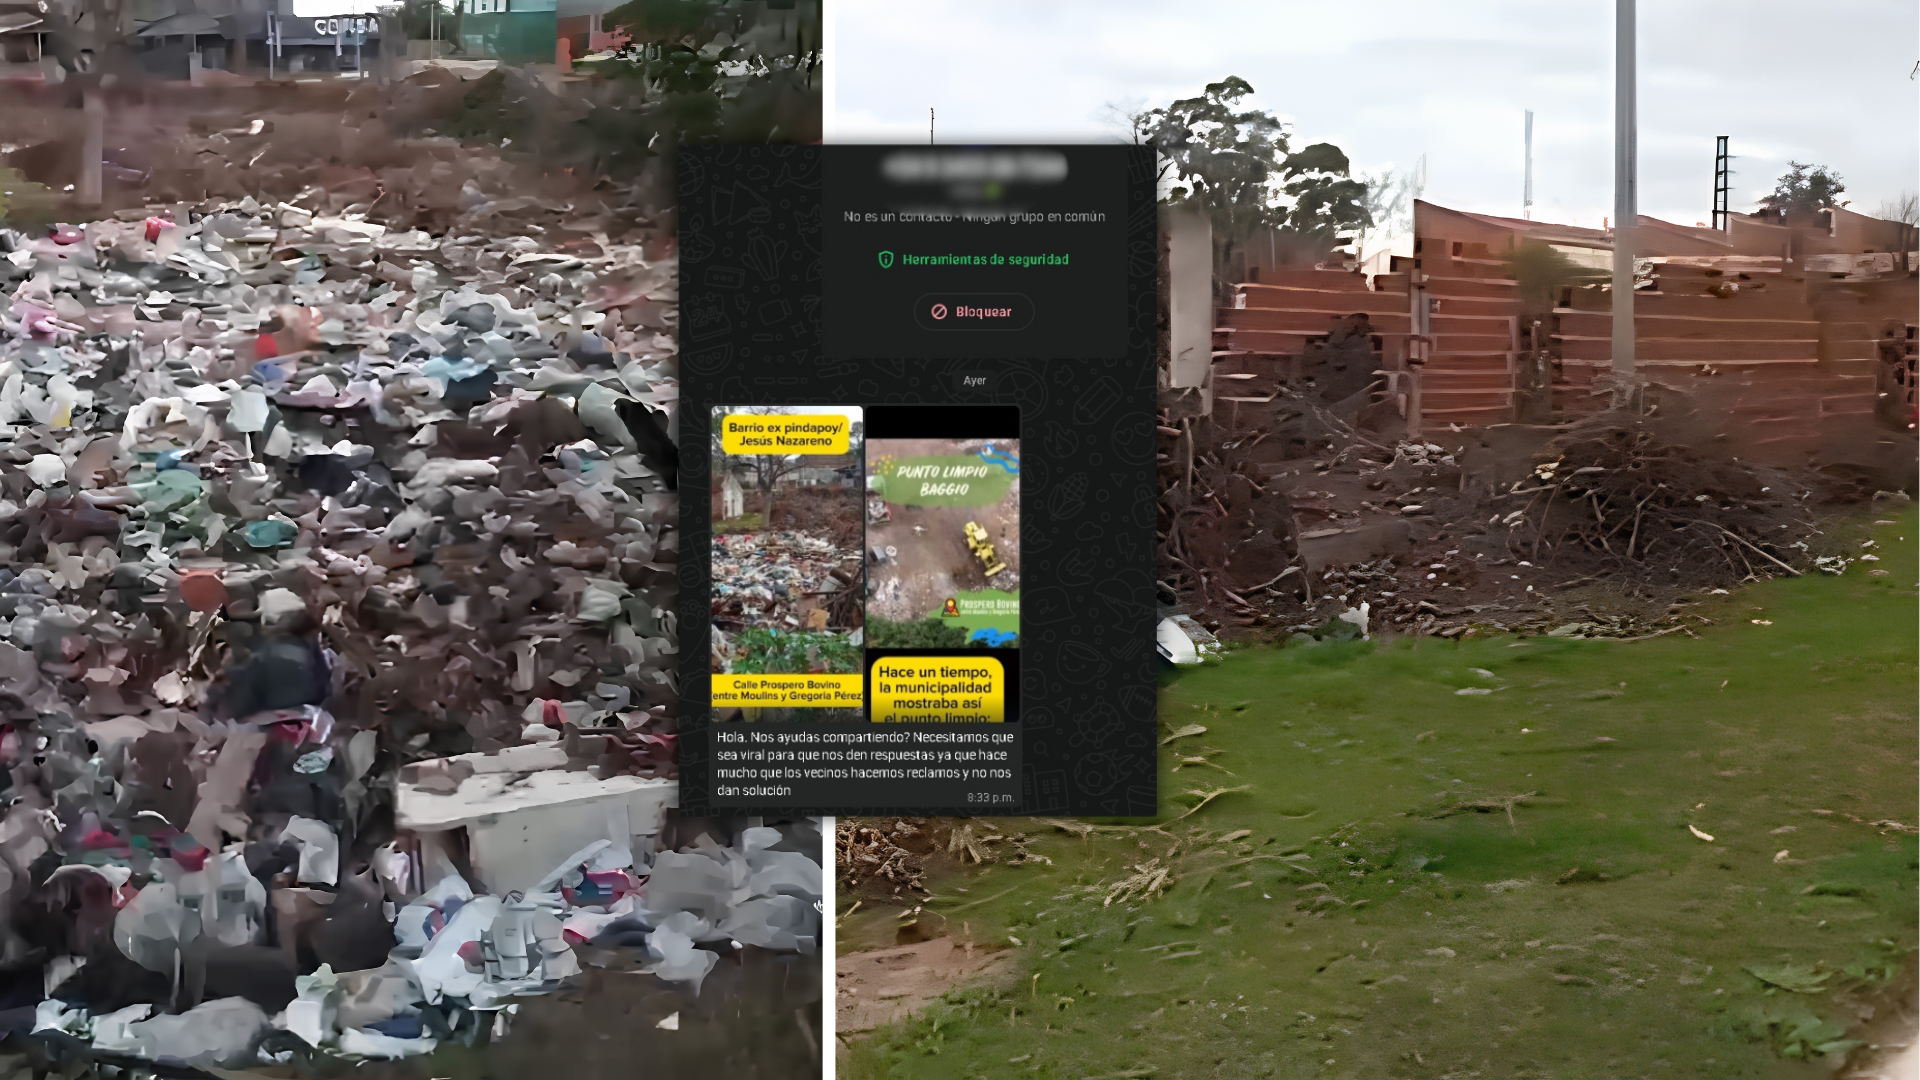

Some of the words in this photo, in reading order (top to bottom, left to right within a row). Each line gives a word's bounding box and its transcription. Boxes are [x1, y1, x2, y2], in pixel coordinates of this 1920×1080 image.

[844, 211, 861, 222] No
[864, 213, 878, 222] es
[881, 212, 896, 222] un
[1009, 212, 1044, 225] grupo
[1047, 213, 1062, 222] en
[1064, 210, 1106, 222] común
[902, 253, 988, 265] Herramientas
[989, 253, 1005, 265] de
[1008, 253, 1069, 268] seguridad
[956, 305, 1012, 320] Bloquear
[963, 375, 987, 388] Ayer
[728, 422, 765, 433] Barrio
[767, 425, 781, 433] ex
[784, 422, 843, 435] pindapoy/
[739, 435, 773, 446] Jesús
[776, 435, 833, 446] Nazareno
[896, 465, 941, 479] PUNTO
[942, 465, 988, 479] LIMPIO
[920, 482, 970, 497] BAGGIO
[878, 665, 915, 678] Hace
[918, 668, 937, 678] un
[940, 666, 992, 680] tiempo,
[733, 680, 758, 690] Calle
[760, 680, 805, 691] Prospero
[806, 680, 841, 690] Bovino
[879, 681, 891, 694] la
[895, 681, 992, 696] municipalidad
[712, 691, 738, 700] entre
[740, 691, 779, 701] Moulins
[780, 694, 787, 702] y
[789, 691, 832, 702] Gregoria
[893, 697, 959, 709] mostraba
[962, 697, 983, 709] así
[883, 713, 897, 723] el
[900, 713, 942, 723] punto
[717, 730, 748, 743] Hola.
[750, 731, 775, 743] Nos
[777, 730, 821, 746] ayudas
[822, 730, 911, 746] compartiendo?
[913, 730, 990, 743] Necesitamos
[991, 733, 1014, 746] que
[717, 750, 738, 761] sea
[739, 748, 765, 761] viral
[767, 751, 795, 764] para
[797, 751, 820, 764] que
[821, 751, 844, 761] nos
[845, 748, 868, 761] den
[870, 750, 936, 764] respuestas
[937, 751, 952, 764] ya
[954, 751, 977, 764] que
[978, 748, 1008, 761] hace
[717, 766, 758, 779] mucho
[760, 768, 783, 781] que
[784, 766, 802, 779] los
[803, 766, 849, 779] vecinos
[850, 766, 905, 779] hacemos
[906, 766, 961, 779] reclamos
[962, 768, 970, 781] y
[972, 768, 987, 779] no
[989, 768, 1012, 779] nos
[717, 784, 740, 796] dan
[742, 784, 791, 796] solución
[967, 792, 990, 803] 8:33
[992, 794, 1015, 806] p.m.
